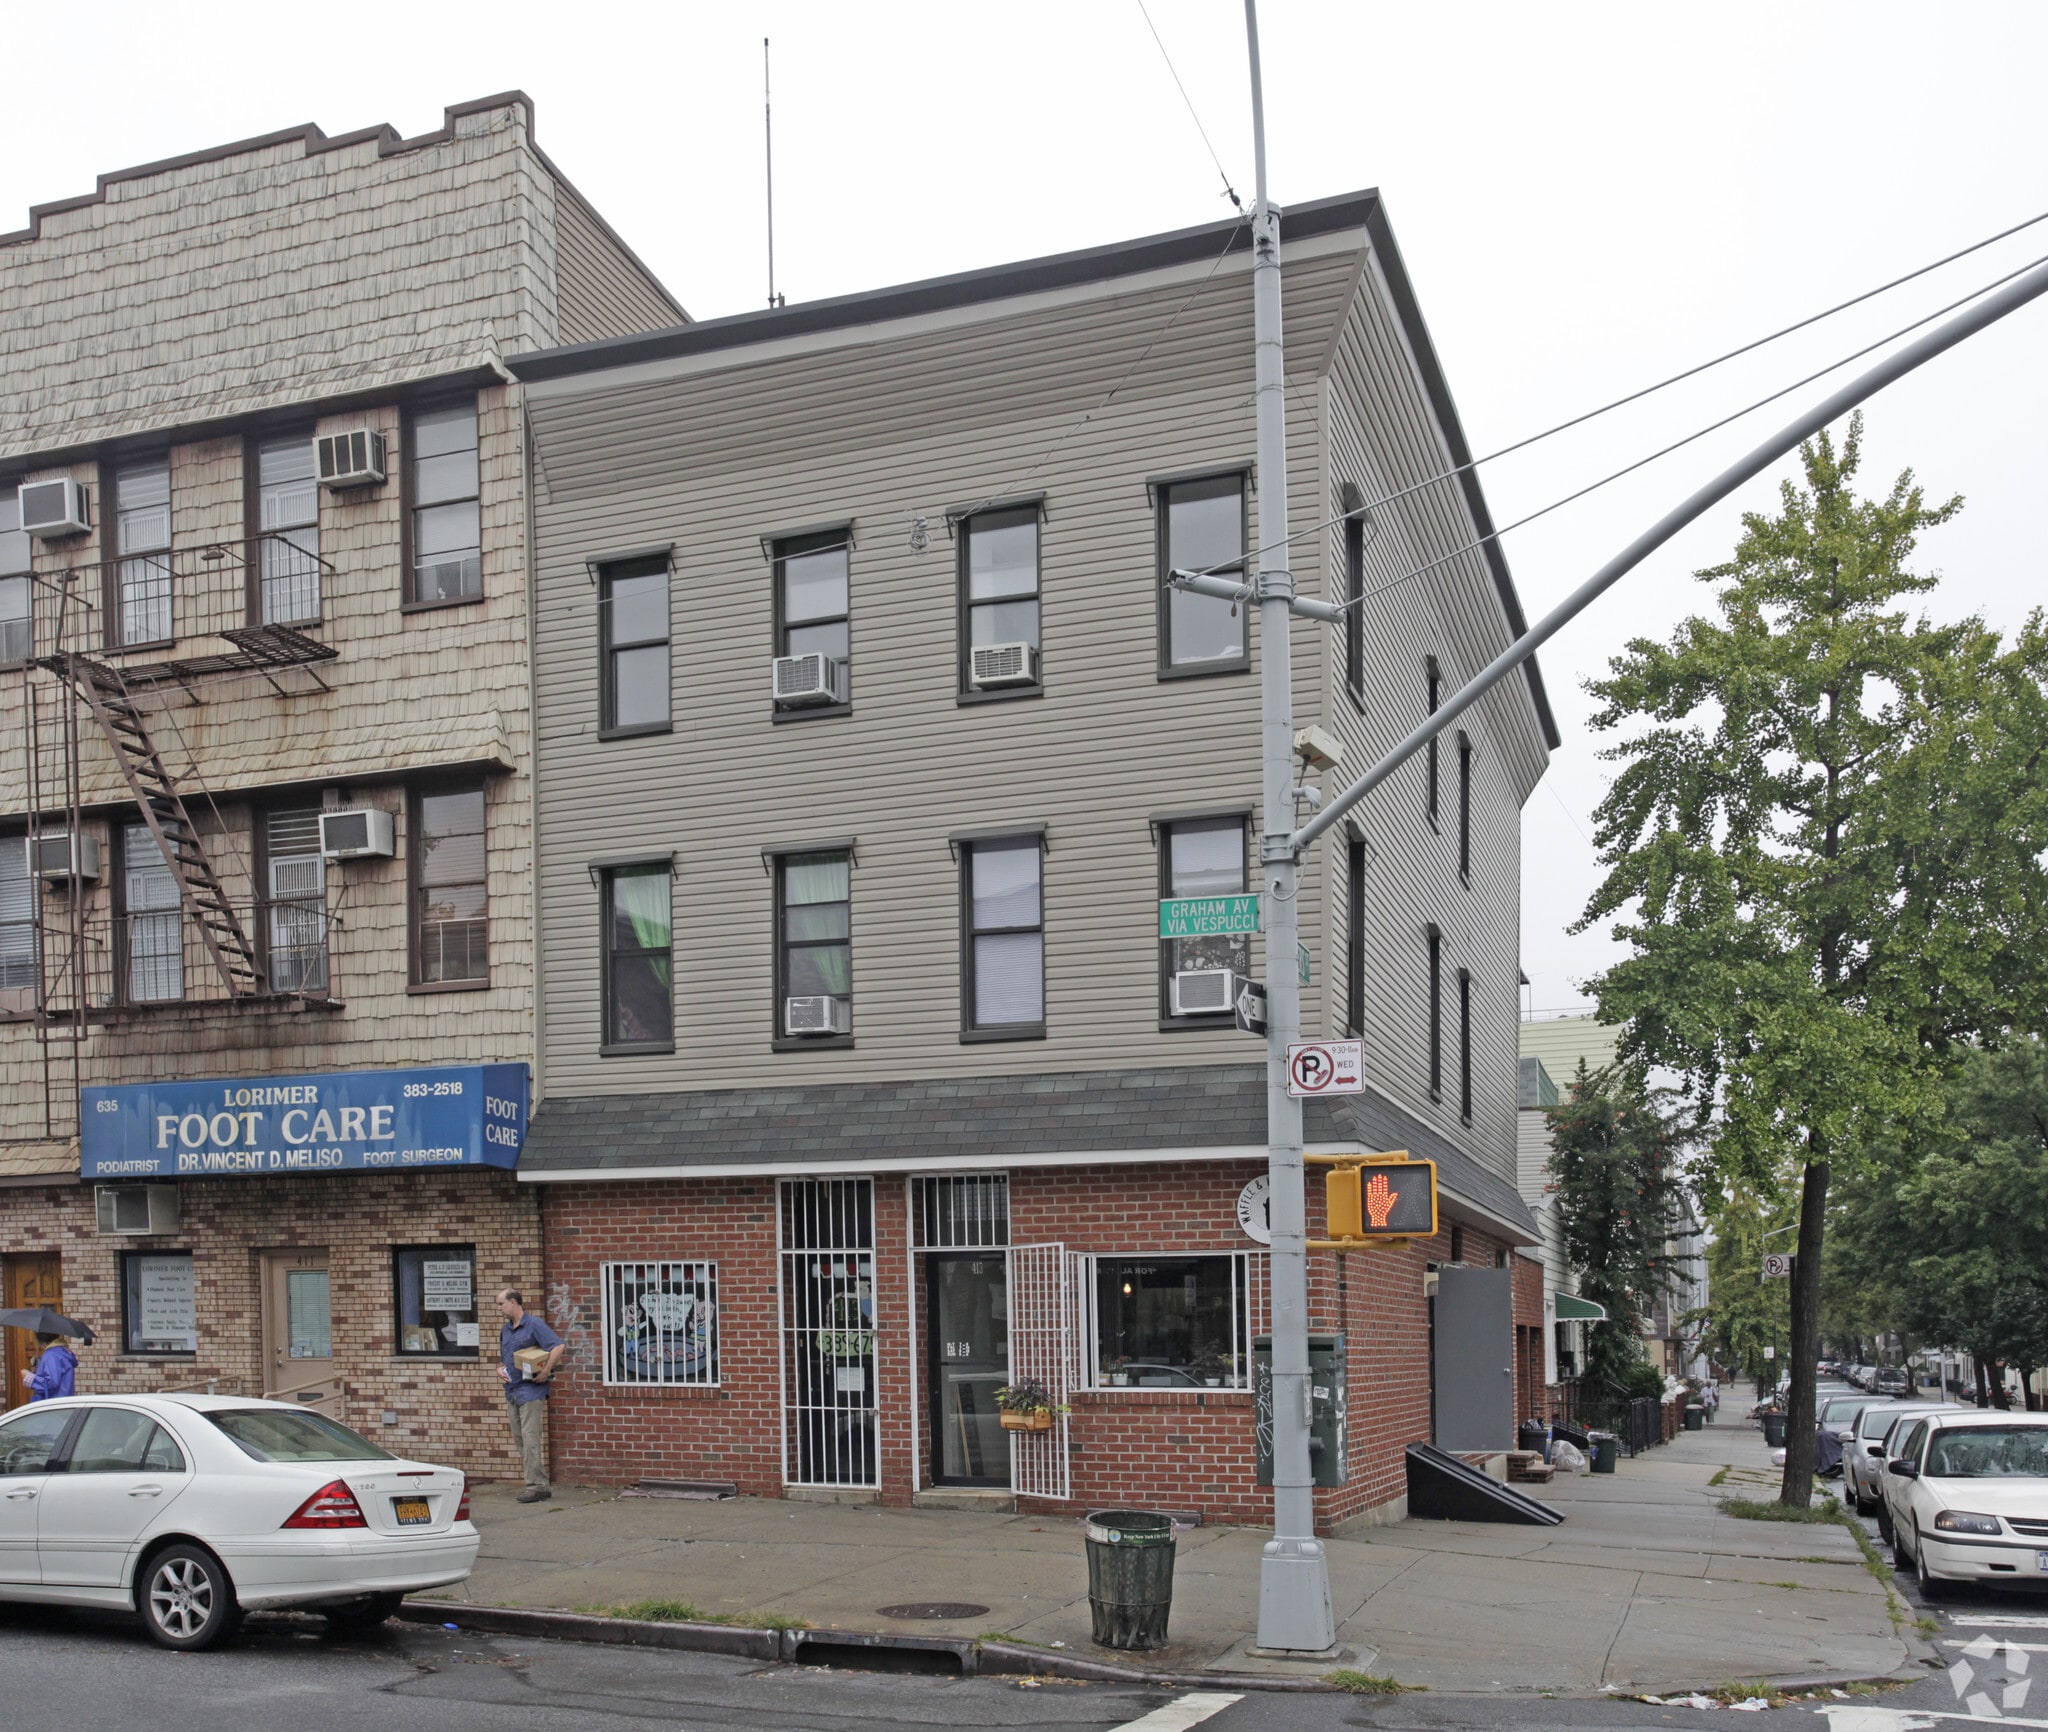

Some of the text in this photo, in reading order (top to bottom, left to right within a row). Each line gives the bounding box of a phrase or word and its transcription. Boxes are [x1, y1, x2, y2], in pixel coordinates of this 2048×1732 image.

[1171, 899, 1249, 917] GRAHAM AV
[1167, 915, 1255, 933] VIA VESPUCCI
[1242, 995, 1257, 1017] ONE
[1336, 1060, 1354, 1069] WED
[224, 1085, 318, 1107] LORIMER
[403, 1082, 463, 1098] 383-2518
[96, 1100, 118, 1113] 635
[485, 1096, 518, 1121] FOOT
[156, 1105, 395, 1149] FOOT CARE
[485, 1123, 518, 1148] CARE
[363, 1147, 463, 1165] FOOT SURGEON
[96, 1159, 160, 1174] PODIATRIST
[1239, 1180, 1264, 1225] WAFFLE &
[297, 1256, 314, 1267] 411
[971, 1262, 984, 1275] 413
